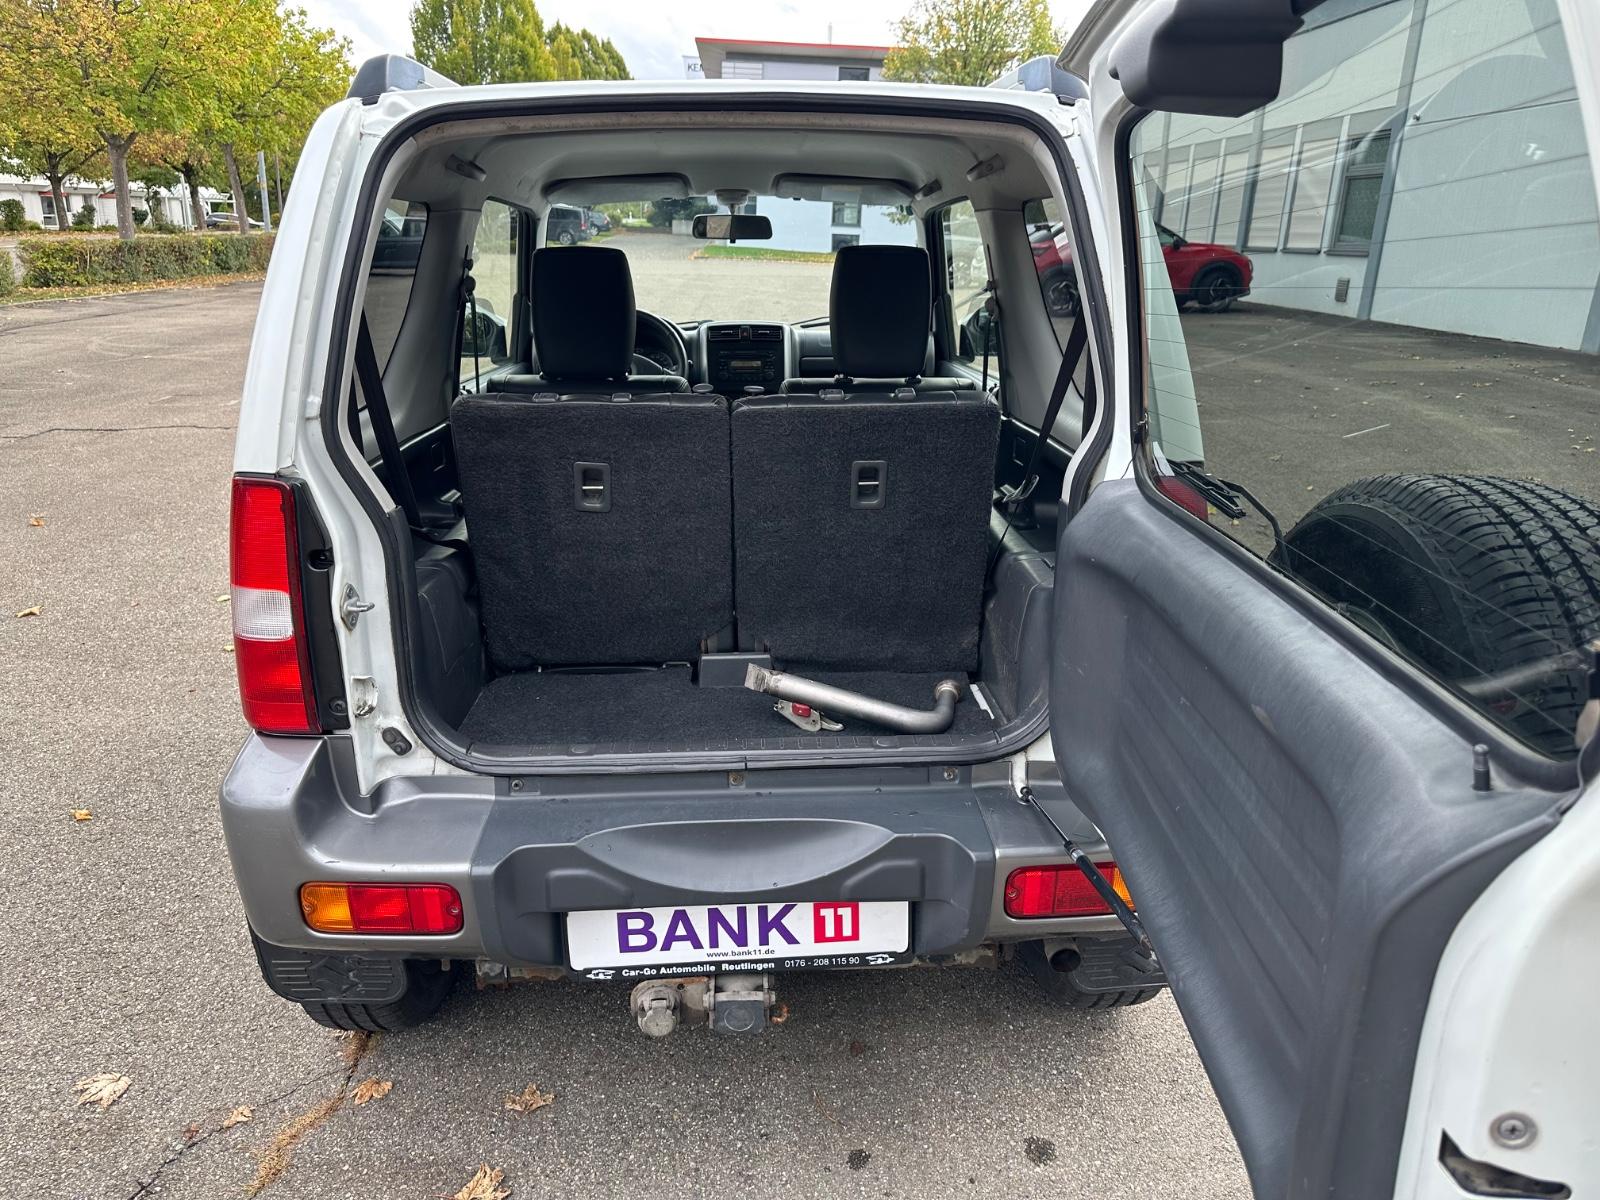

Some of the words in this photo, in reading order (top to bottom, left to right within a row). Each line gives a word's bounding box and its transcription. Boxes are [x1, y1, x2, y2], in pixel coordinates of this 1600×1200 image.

[617, 904, 800, 953] BANK
[819, 907, 852, 938] 11
[706, 948, 775, 958] www.bank11.de
[622, 967, 657, 977] Car-Go
[659, 964, 716, 975] Automobile
[721, 961, 775, 971] Reutlingen
[784, 959, 806, 968] 0176
[813, 957, 829, 966] 208
[832, 957, 847, 966] 115
[848, 956, 860, 965] 90
